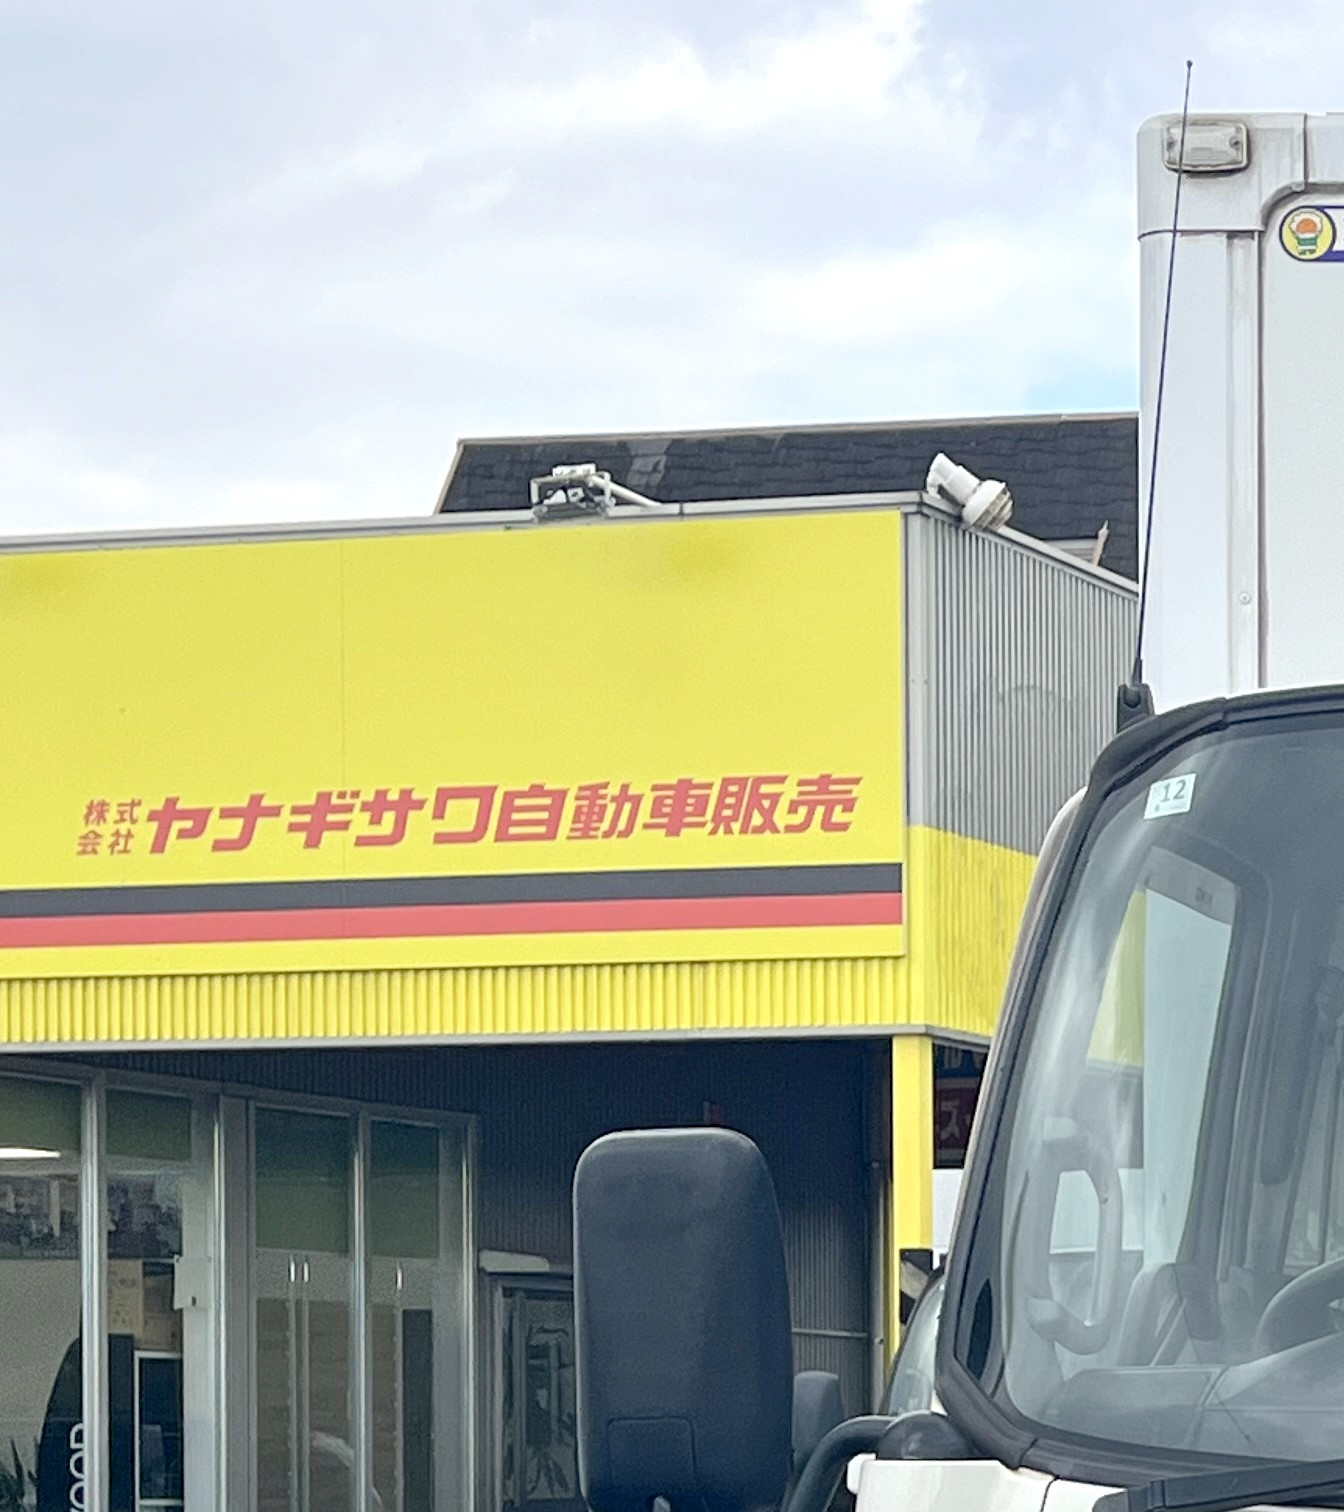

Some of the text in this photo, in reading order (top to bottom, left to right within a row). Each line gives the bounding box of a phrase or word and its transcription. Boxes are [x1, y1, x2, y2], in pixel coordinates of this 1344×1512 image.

[1160, 779, 1187, 802] 12
[83, 797, 142, 826] 株式
[147, 774, 863, 855] ヤナギサワ自動車販売
[76, 827, 135, 856] 会社
